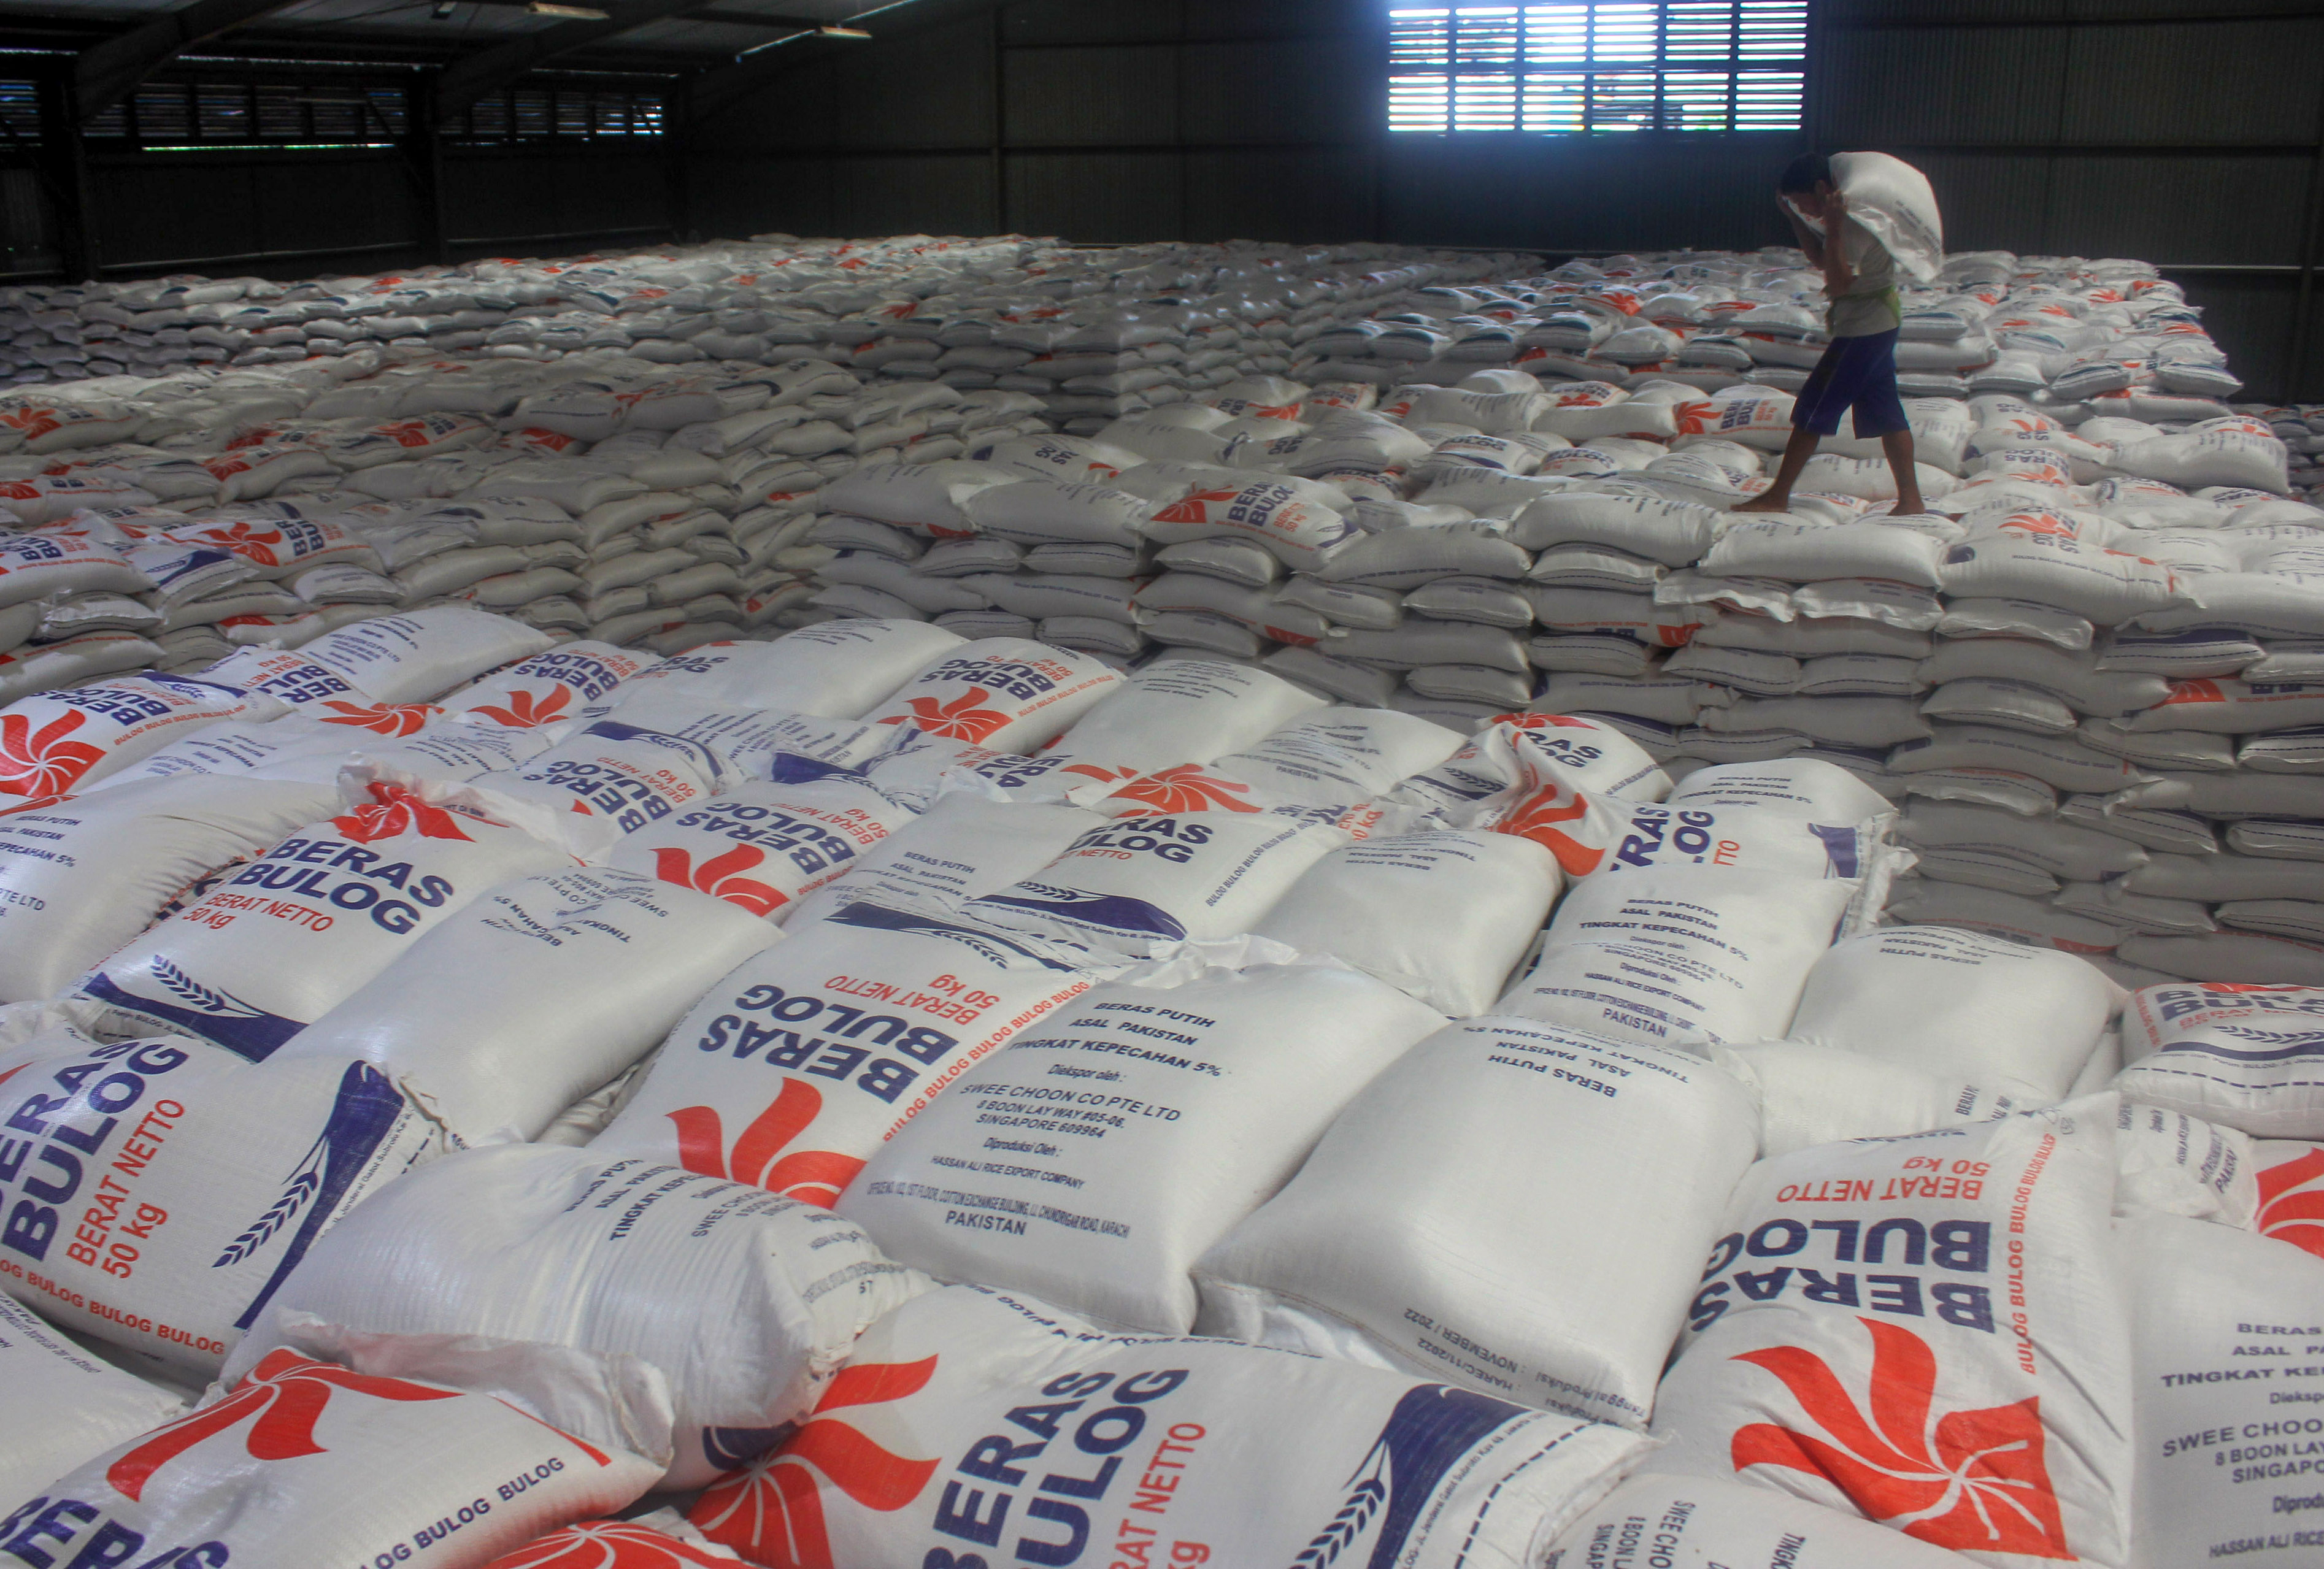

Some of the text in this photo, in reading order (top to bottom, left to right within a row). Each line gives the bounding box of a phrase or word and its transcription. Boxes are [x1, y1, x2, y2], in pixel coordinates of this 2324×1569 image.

[514, 664, 602, 701] BERAS
[529, 653, 620, 691] BULOG
[547, 761, 673, 820] BULOG
[639, 774, 686, 804] BERAT
[675, 783, 697, 798] 50
[17, 827, 66, 840] PAKISTAN
[46, 816, 83, 826] PUTIH
[705, 802, 856, 864] BULOG
[817, 813, 874, 845] BERAT
[844, 808, 890, 838] 50 kg
[675, 812, 828, 875] BERAS
[1075, 849, 1133, 860] NETTO
[56, 854, 77, 867] 5%
[264, 838, 454, 908] BERAS
[890, 862, 967, 886] ASAL PAKISTAN
[904, 851, 977, 873] BERAS PUTIH
[1206, 886, 1226, 907] BULOG
[1223, 865, 1245, 888] BULOG
[1242, 846, 1264, 868] BULOG
[18, 892, 47, 911] LTD
[228, 862, 421, 935] BULOG
[797, 879, 825, 896] BULOG
[182, 907, 237, 930] 50 kg
[204, 892, 334, 932] BERAT NETTO
[1658, 911, 1718, 930] PAKISTAN
[1676, 902, 1719, 918] PUTIH
[1641, 923, 1727, 949] KEPECAHAN
[1729, 946, 1749, 962] 5%
[1879, 947, 1982, 965] BERAS PUTIH
[1883, 938, 1948, 950] PAKISTAN
[1666, 953, 1687, 962] CO
[1690, 959, 1717, 975] PTE
[824, 975, 982, 1026] BERAT NETTO
[928, 974, 1001, 1010] 50 kg
[2155, 990, 2324, 1007] BERA
[735, 984, 960, 1065] BULOG
[1093, 1002, 1217, 1027] BERAS PUTIH
[1603, 1007, 1669, 1038] PAKISTAN
[2160, 1000, 2324, 1022] BULO
[925, 981, 1091, 1098] BULOG BULOG BULOG BULOG
[1069, 1018, 1198, 1046] ASAL PAKISTAN
[1491, 1027, 1603, 1053] KEPECAHAN
[698, 1014, 920, 1103] BERAS
[1047, 1064, 1120, 1081] Diekspor oleh
[1080, 1040, 1191, 1070] KEPECAHAN
[1193, 1062, 1222, 1077] 5%
[1496, 1042, 1633, 1078] ASAL PAKISTAN
[1607, 1051, 1690, 1084] TINGKAT
[1488, 1054, 1618, 1098] BERAS PUTIH
[960, 1084, 1182, 1121] SWEE CHOON CO PTE LTD
[988, 1101, 1023, 1114] BOON
[1027, 1105, 1055, 1118] LAY
[1052, 1107, 1084, 1120] WAY
[0, 1042, 141, 1213] ERAS
[975, 1113, 1107, 1138] SINGAPORE 609964
[1, 1043, 190, 1262] BULOG
[983, 1137, 1057, 1157] Diproduksi Oleh
[930, 1155, 1086, 1189] HASSAN ALI RICE EXPORT COMPANY
[1903, 1155, 1991, 1178] 50 kg
[66, 1099, 185, 1268] BERAT NETTO
[1777, 1174, 1984, 1203] BERAT NETTO
[609, 1192, 663, 1241] TINGKAT
[691, 1209, 729, 1238] SWEE
[945, 1210, 1027, 1235] PAKISTAN
[101, 1202, 169, 1279] 50 kg
[1700, 1218, 1991, 1283] BULOG
[2007, 1158, 2046, 1375] BULOG BULOG BULOG BULOG
[27, 1270, 226, 1356] BULOG BULOG BULOG
[1689, 1266, 1996, 1334] BERAS
[1404, 1308, 1518, 1373] NOVEMBER 2022
[2237, 1323, 2322, 1335] BERAS
[1417, 1338, 1514, 1391] HAREC/11/2022
[2231, 1346, 2291, 1356] ASAL
[2161, 1369, 2275, 1387] TINGKAT
[2162, 1419, 2324, 1457] SWEE CHOO
[1015, 1370, 1190, 1569] ULOG
[1129, 1422, 1207, 1514] NETTO
[2215, 1443, 2288, 1466] 8 BOON
[2232, 1459, 2324, 1483] SINGAPO
[414, 1457, 565, 1552] BULOG BULOG
[1615, 1523, 1644, 1556] BOON
[1649, 1500, 1696, 1569] SWEE CHO
[2209, 1535, 2289, 1557] HASSAN ALI
